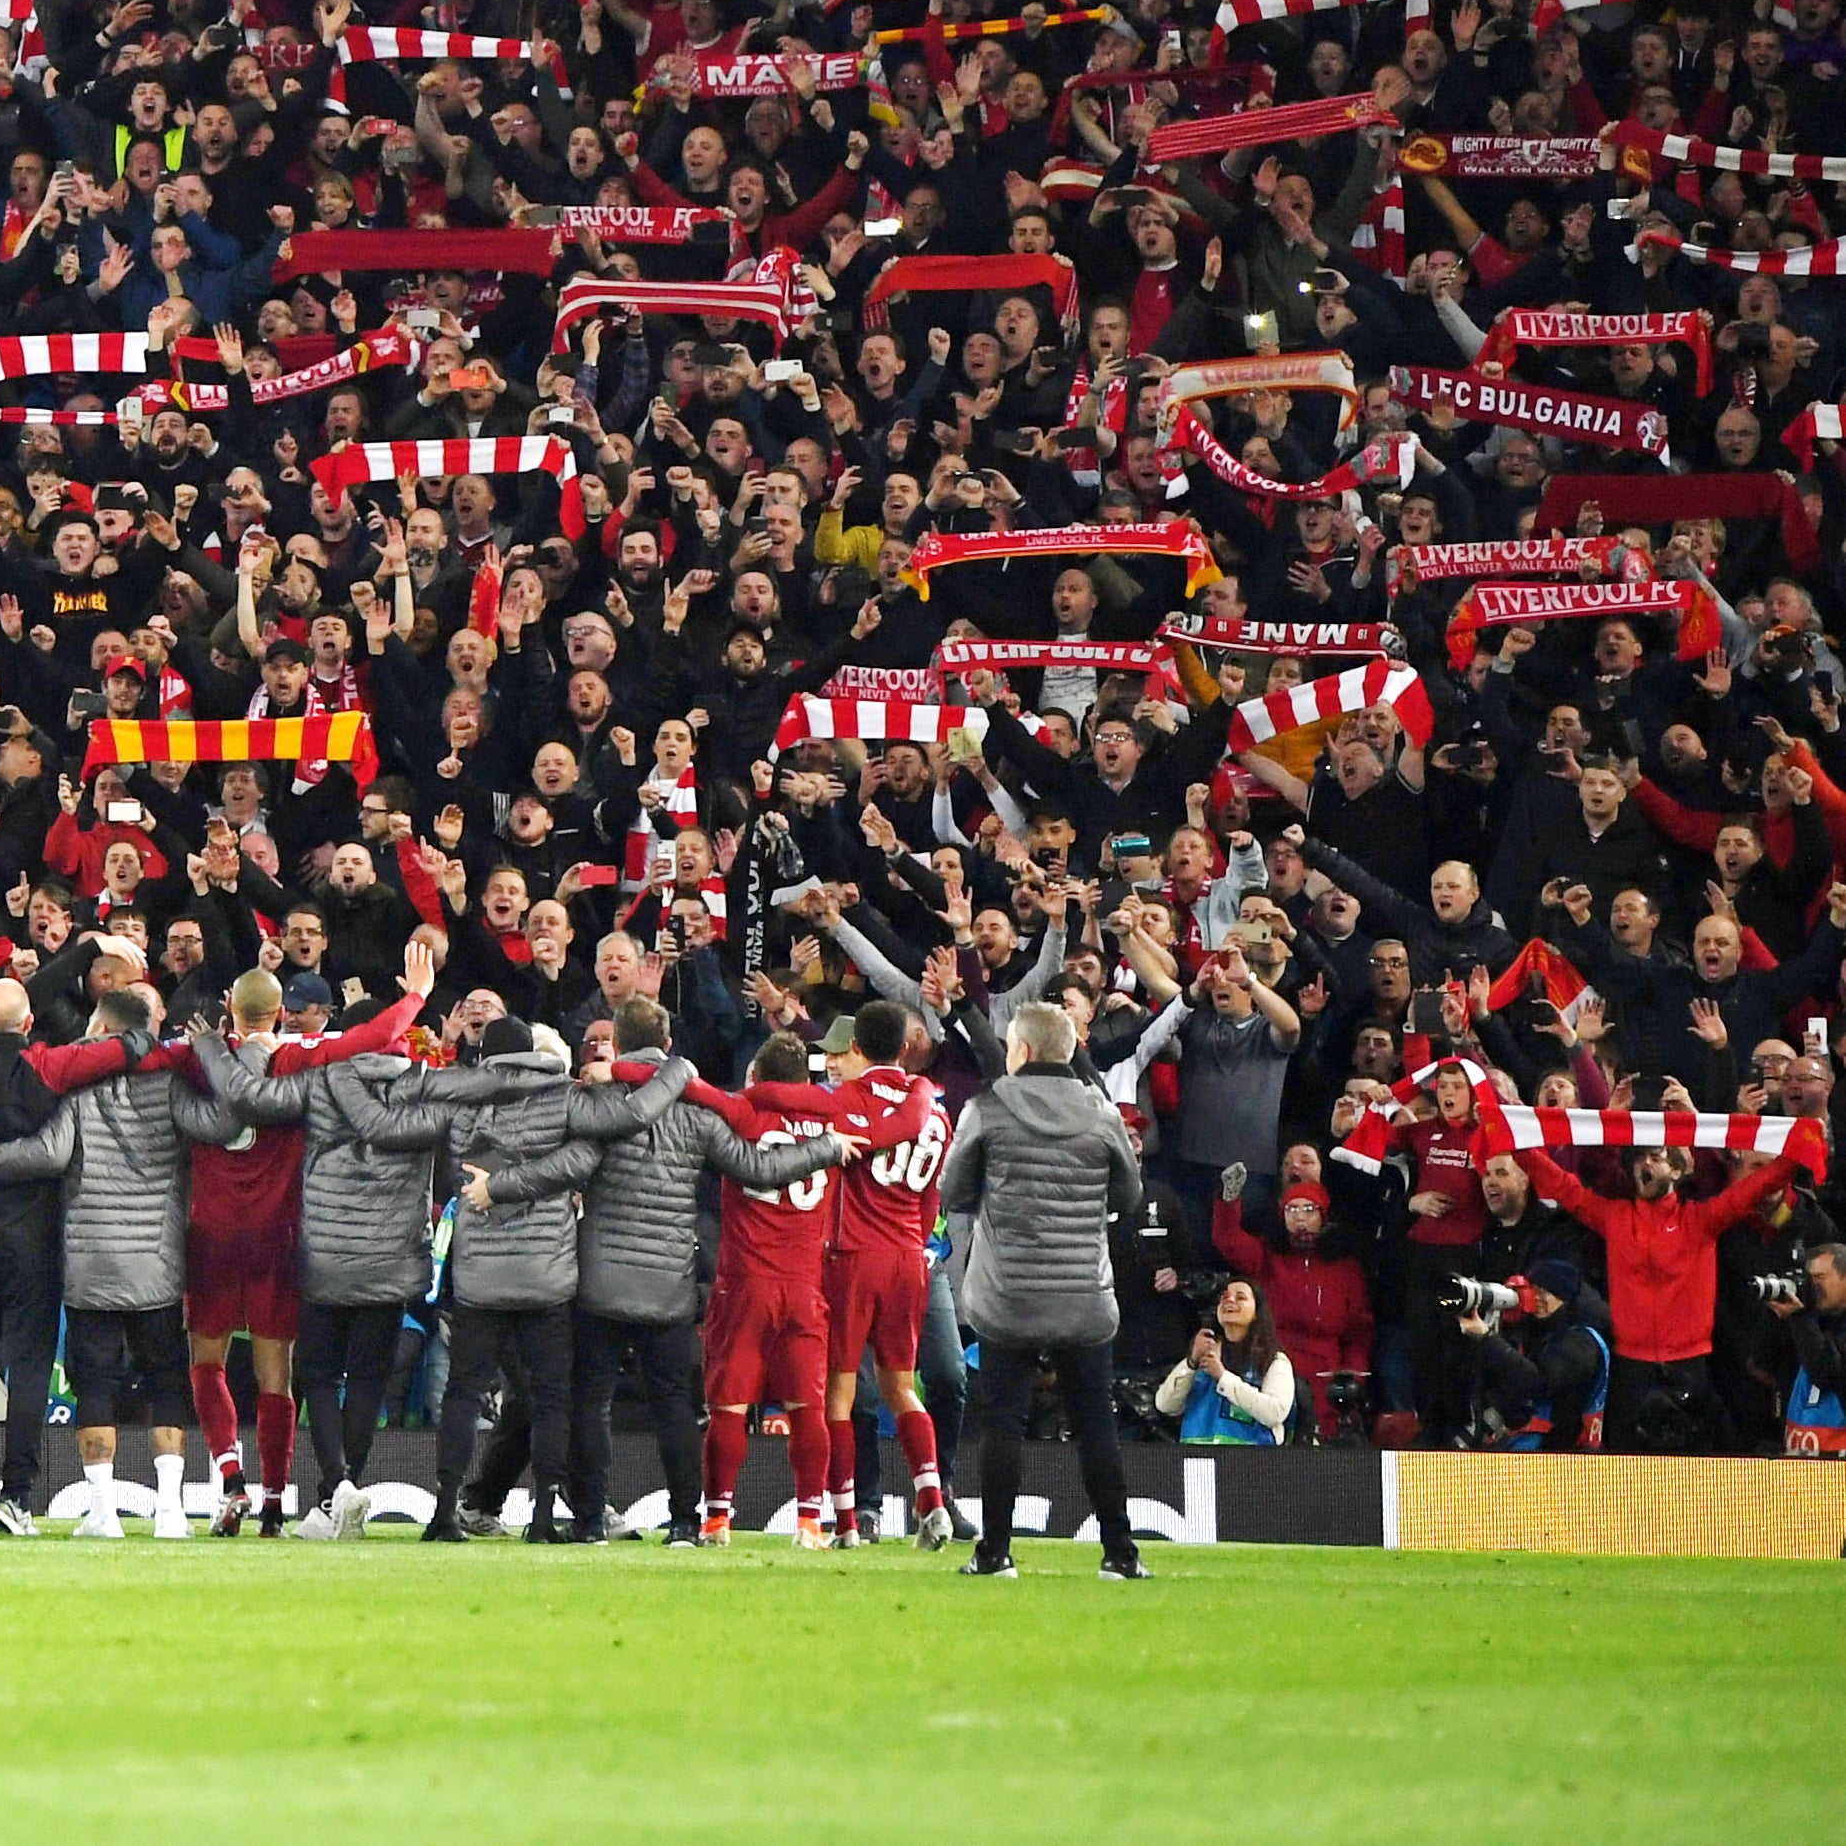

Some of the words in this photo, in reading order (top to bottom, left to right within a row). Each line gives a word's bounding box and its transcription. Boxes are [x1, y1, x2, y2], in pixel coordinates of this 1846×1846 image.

[1452, 136, 1494, 152] MIGHTY
[1493, 137, 1522, 150] REDS
[1464, 165, 1506, 174] WALK
[1510, 166, 1532, 174] ON
[1536, 165, 1577, 174] WALK
[1514, 312, 1655, 337] LIVERPOOL
[1662, 312, 1692, 333] FC
[1420, 373, 1472, 407] LFC
[1478, 385, 1622, 436] BULGARIA
[1002, 525, 1102, 538] CHAMPIONS
[1105, 522, 1170, 535] LEAGUE
[1411, 538, 1558, 568] LIVERPOOL
[1563, 536, 1597, 558] FC
[1418, 564, 1461, 579] YOU'LL
[1464, 561, 1503, 575] NEVER
[1510, 560, 1544, 572] WALK
[1550, 559, 1580, 571] ALON
[1476, 585, 1645, 618] LIVERPOOL
[1650, 580, 1682, 602] FC
[940, 643, 1109, 664] LIVERPOOL
[858, 687, 892, 701] NEVER
[901, 688, 924, 700] WAL
[750, 920, 764, 967] NEVER
[1425, 1156, 1466, 1168] Chartered
[1429, 1146, 1468, 1158] Standard
